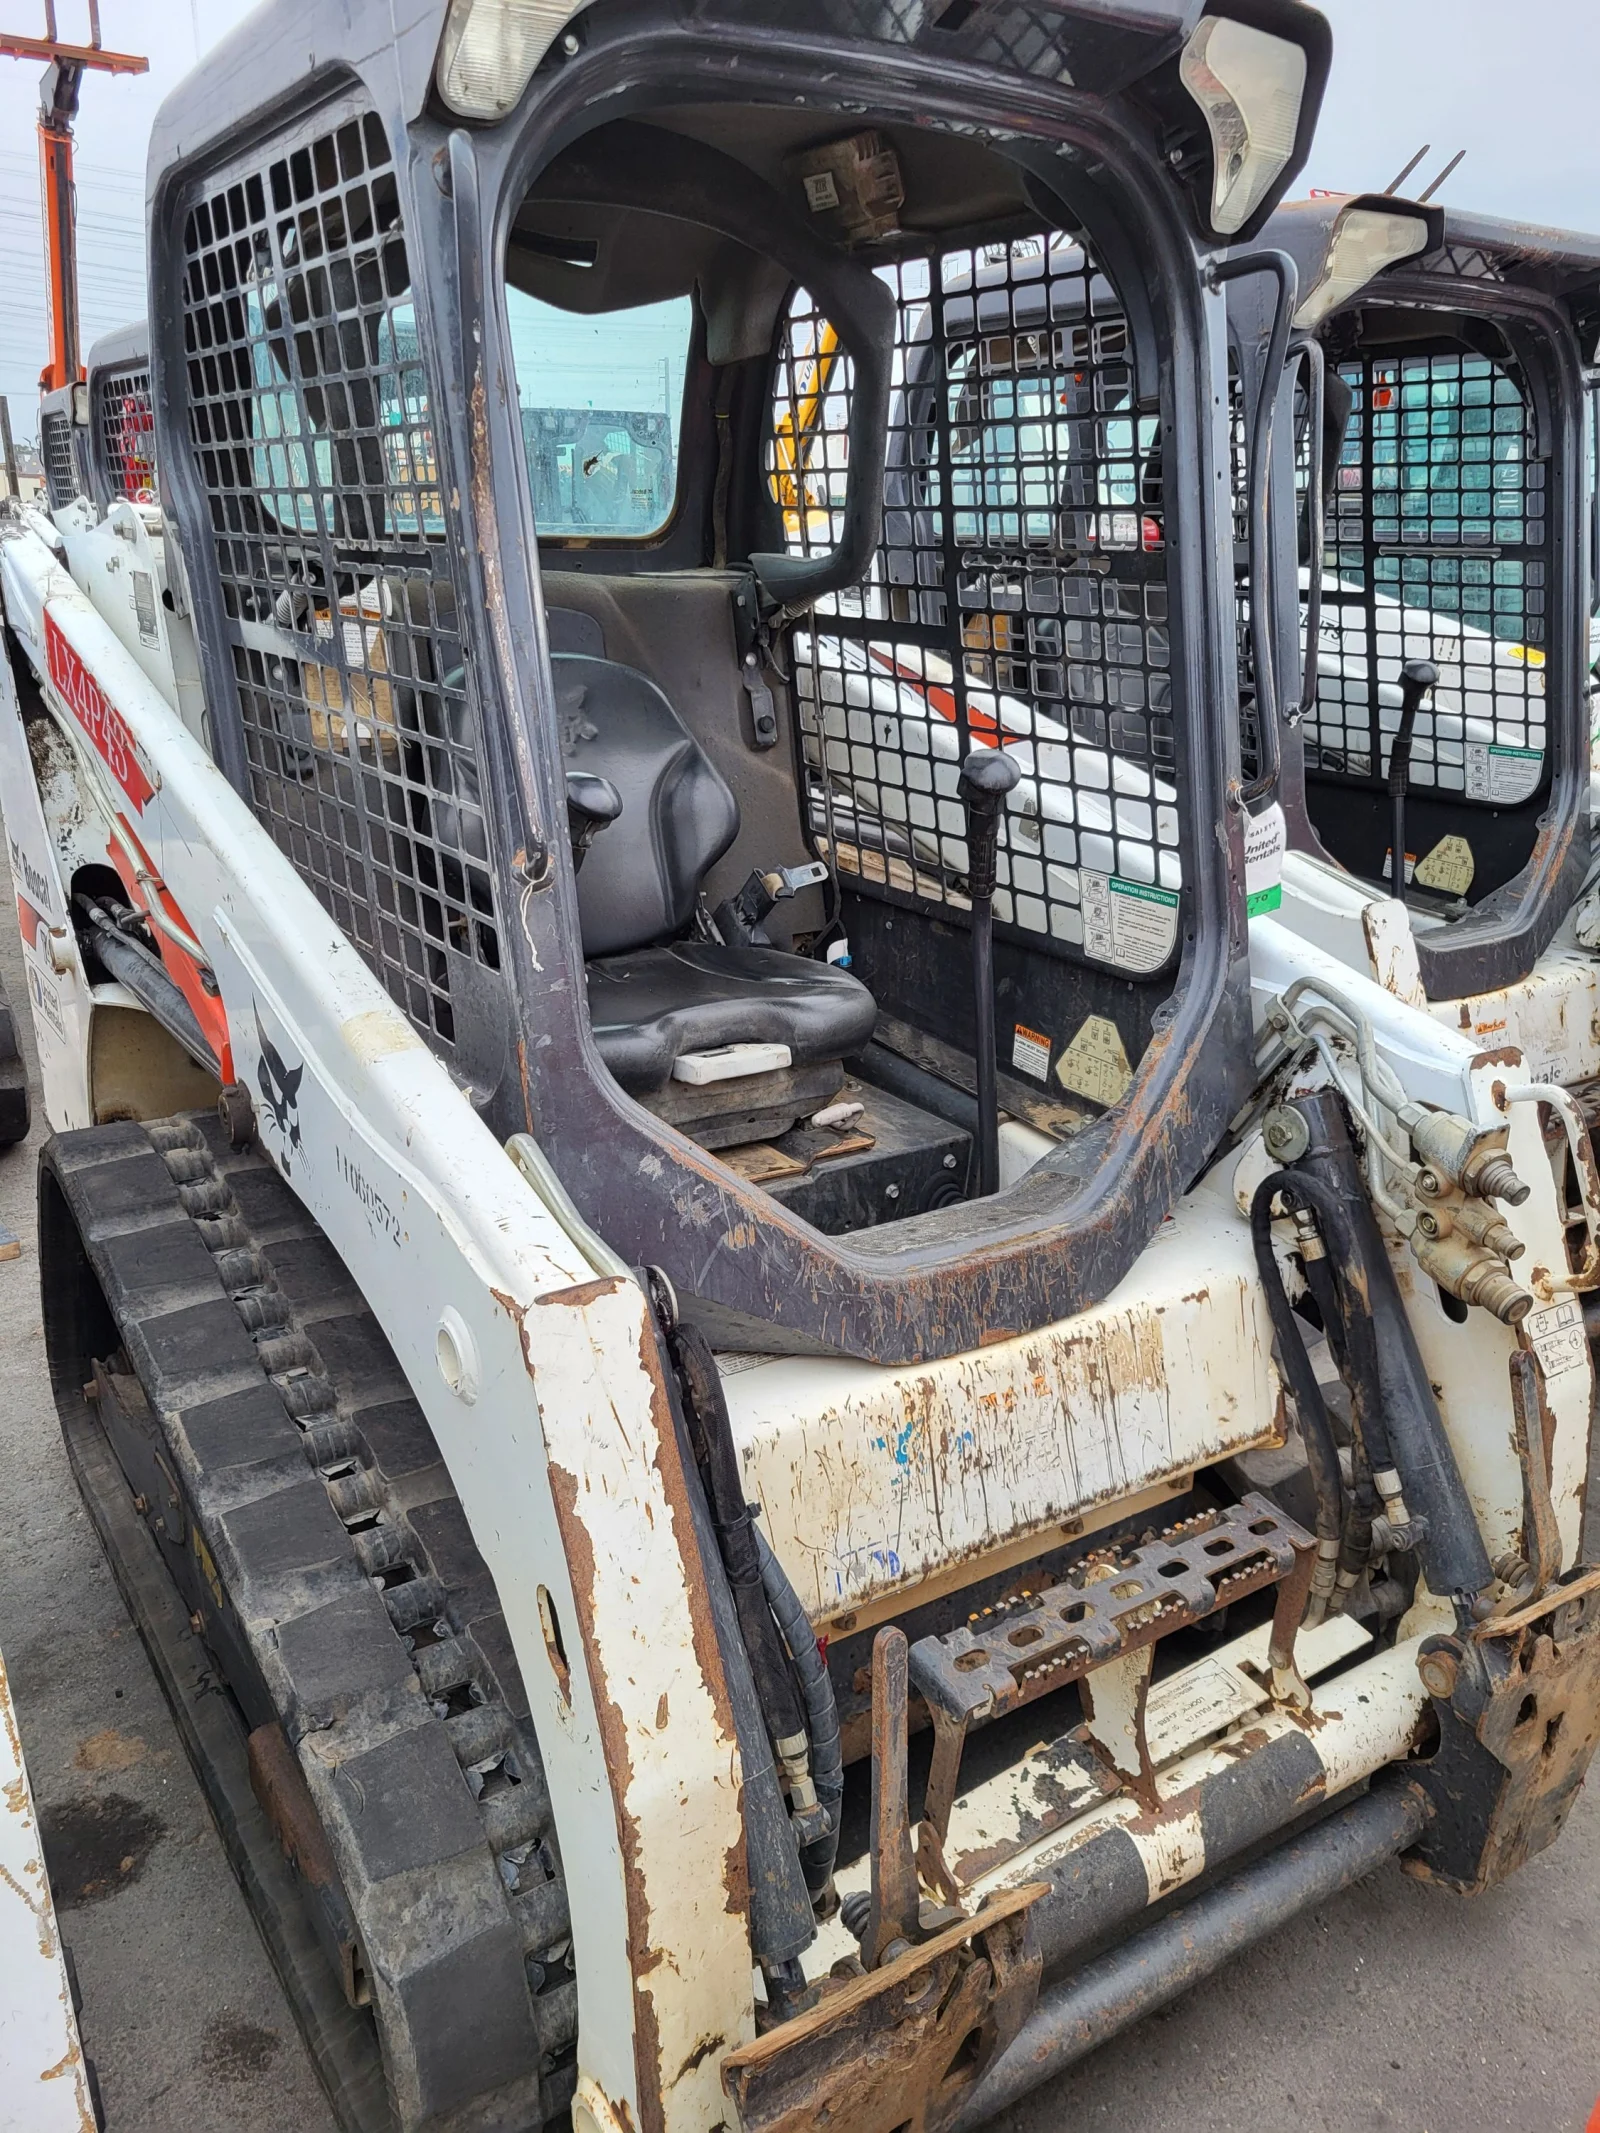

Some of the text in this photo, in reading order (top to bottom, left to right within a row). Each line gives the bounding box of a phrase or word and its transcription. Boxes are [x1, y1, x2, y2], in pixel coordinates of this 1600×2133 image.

[1111, 881, 1176, 905] OPERATION INSTRUCTIONS
[1255, 894, 1268, 903] TO
[1022, 1028, 1049, 1048] WARNING
[1194, 1705, 1212, 1719] FULLY
